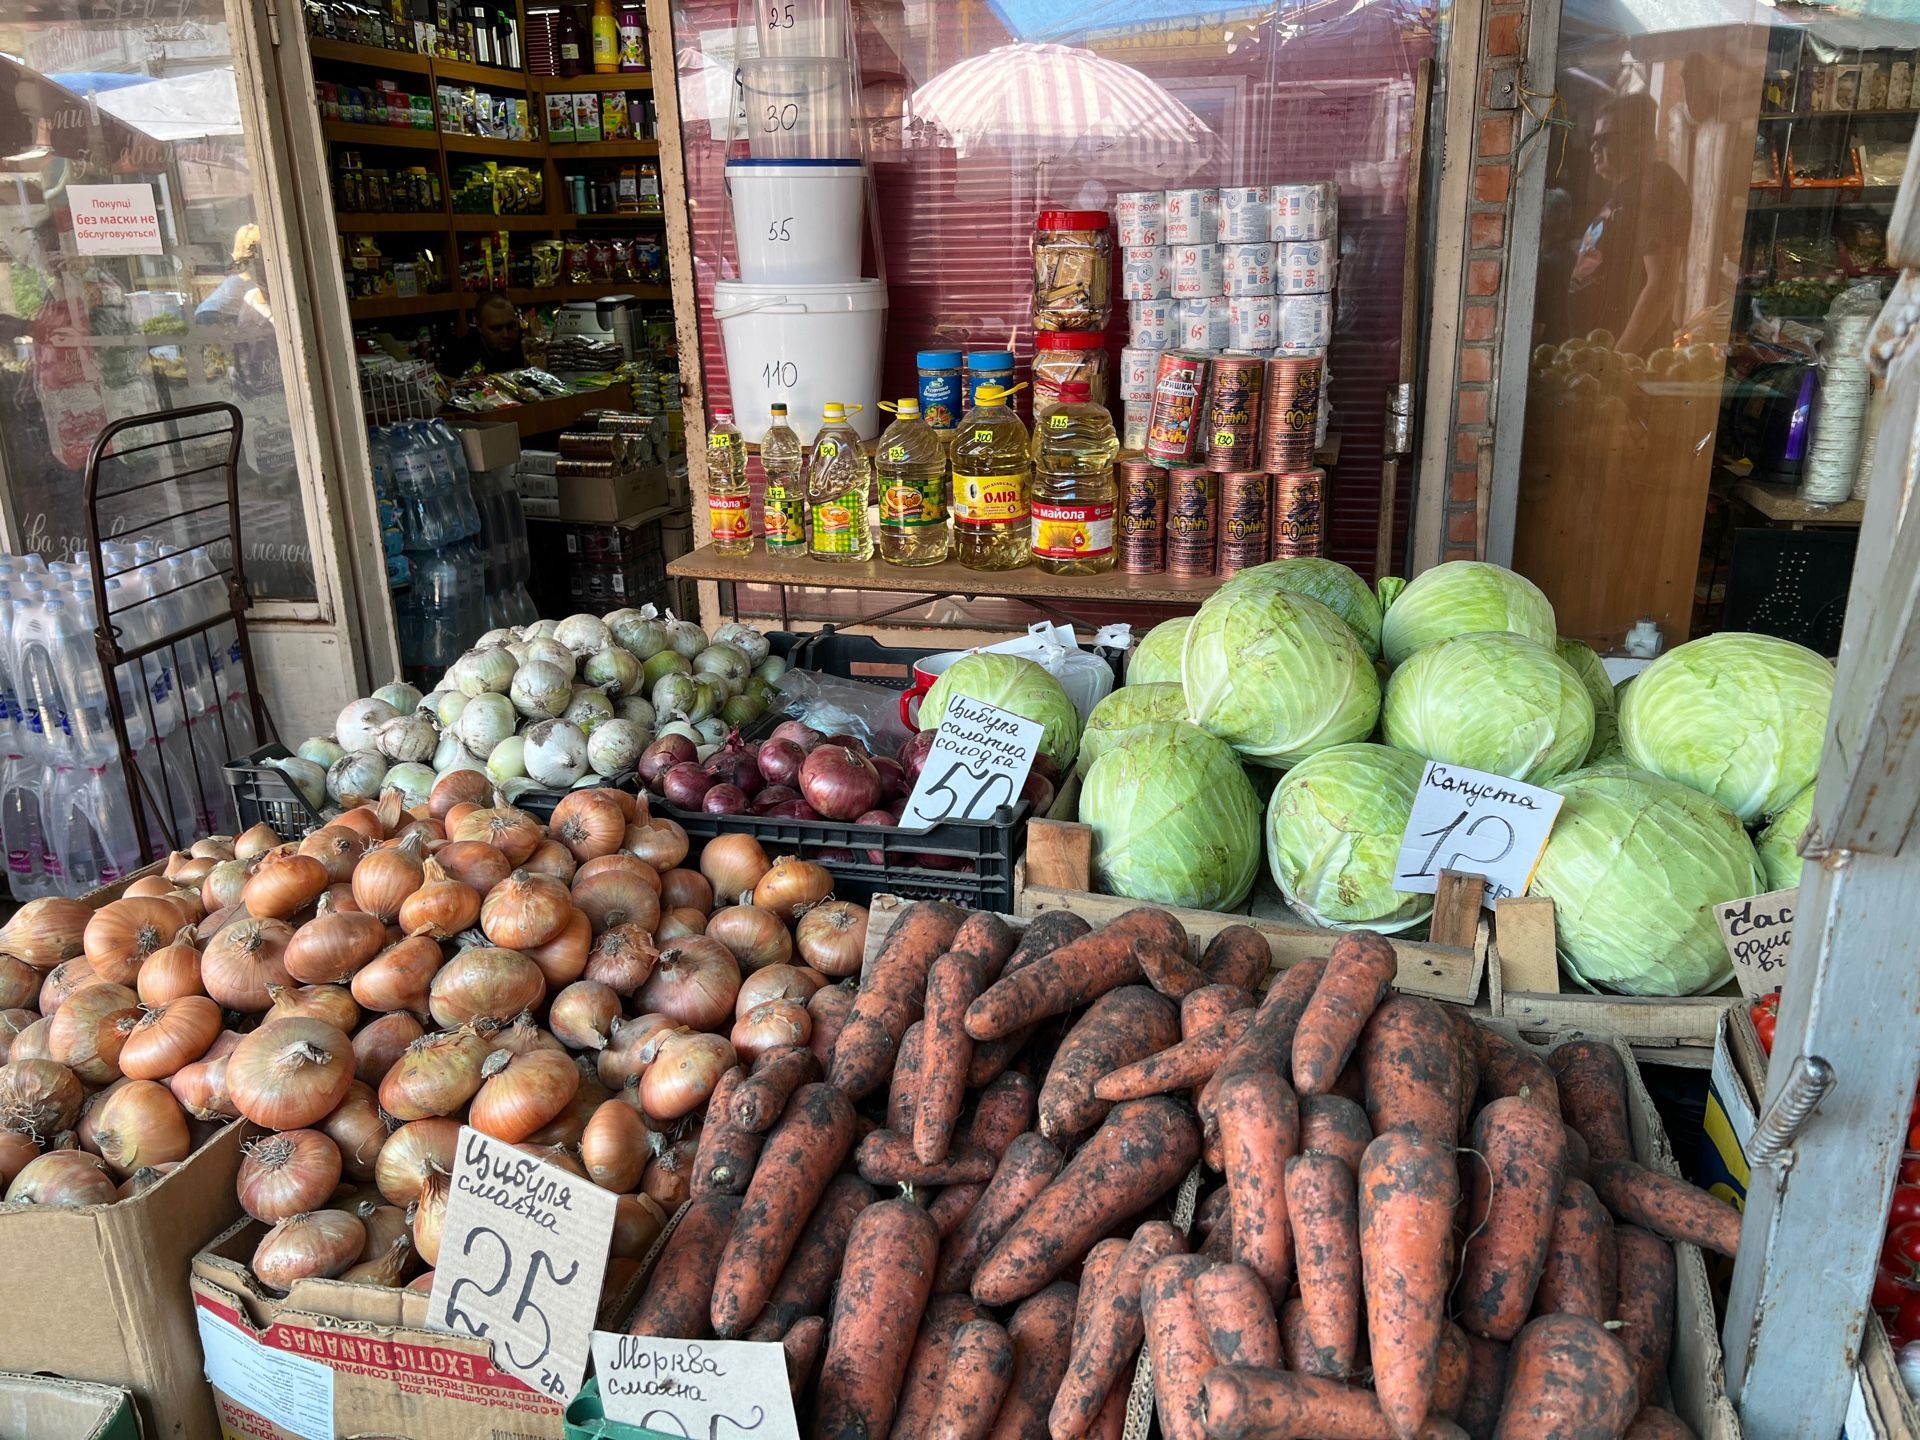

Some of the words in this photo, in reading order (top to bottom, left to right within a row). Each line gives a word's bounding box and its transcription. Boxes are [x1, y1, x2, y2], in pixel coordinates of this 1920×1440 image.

[769, 4, 795, 29] 25
[764, 104, 798, 132] 30
[92, 199, 131, 211] Покупці
[77, 213, 97, 225] без
[100, 215, 137, 225] маски
[141, 215, 155, 224] не
[768, 217, 794, 241] 55
[78, 229, 156, 239] обслуговуються!
[763, 361, 797, 388] 110
[715, 436, 728, 448] 47
[1216, 433, 1233, 446] 130
[771, 488, 783, 499] 47
[984, 491, 1016, 503] ОЛІЯ
[1040, 507, 1085, 520] майола
[948, 695, 1019, 737] Цибуля
[935, 738, 1018, 769] солодка
[941, 720, 1026, 762] салатна
[913, 761, 1014, 822] 50
[1424, 762, 1543, 810] Капуста
[1400, 810, 1515, 878] 12
[465, 1134, 573, 1211] Цибуля
[458, 1176, 559, 1235] смачна
[445, 1226, 579, 1370] 25
[278, 1327, 388, 1365] BANANAS
[610, 1336, 727, 1378] Морква
[396, 1346, 474, 1379] EXOTIC
[391, 1371, 426, 1387] FRUIT
[427, 1377, 465, 1393] FRESH
[467, 1384, 500, 1397] DOLE
[608, 1377, 707, 1402] смачна
[490, 1399, 516, 1411] Food
[502, 1390, 515, 1399] BY
[222, 1401, 272, 1430] ECUADOR
[225, 1415, 240, 1427] OF
[515, 1403, 539, 1414] Dole
